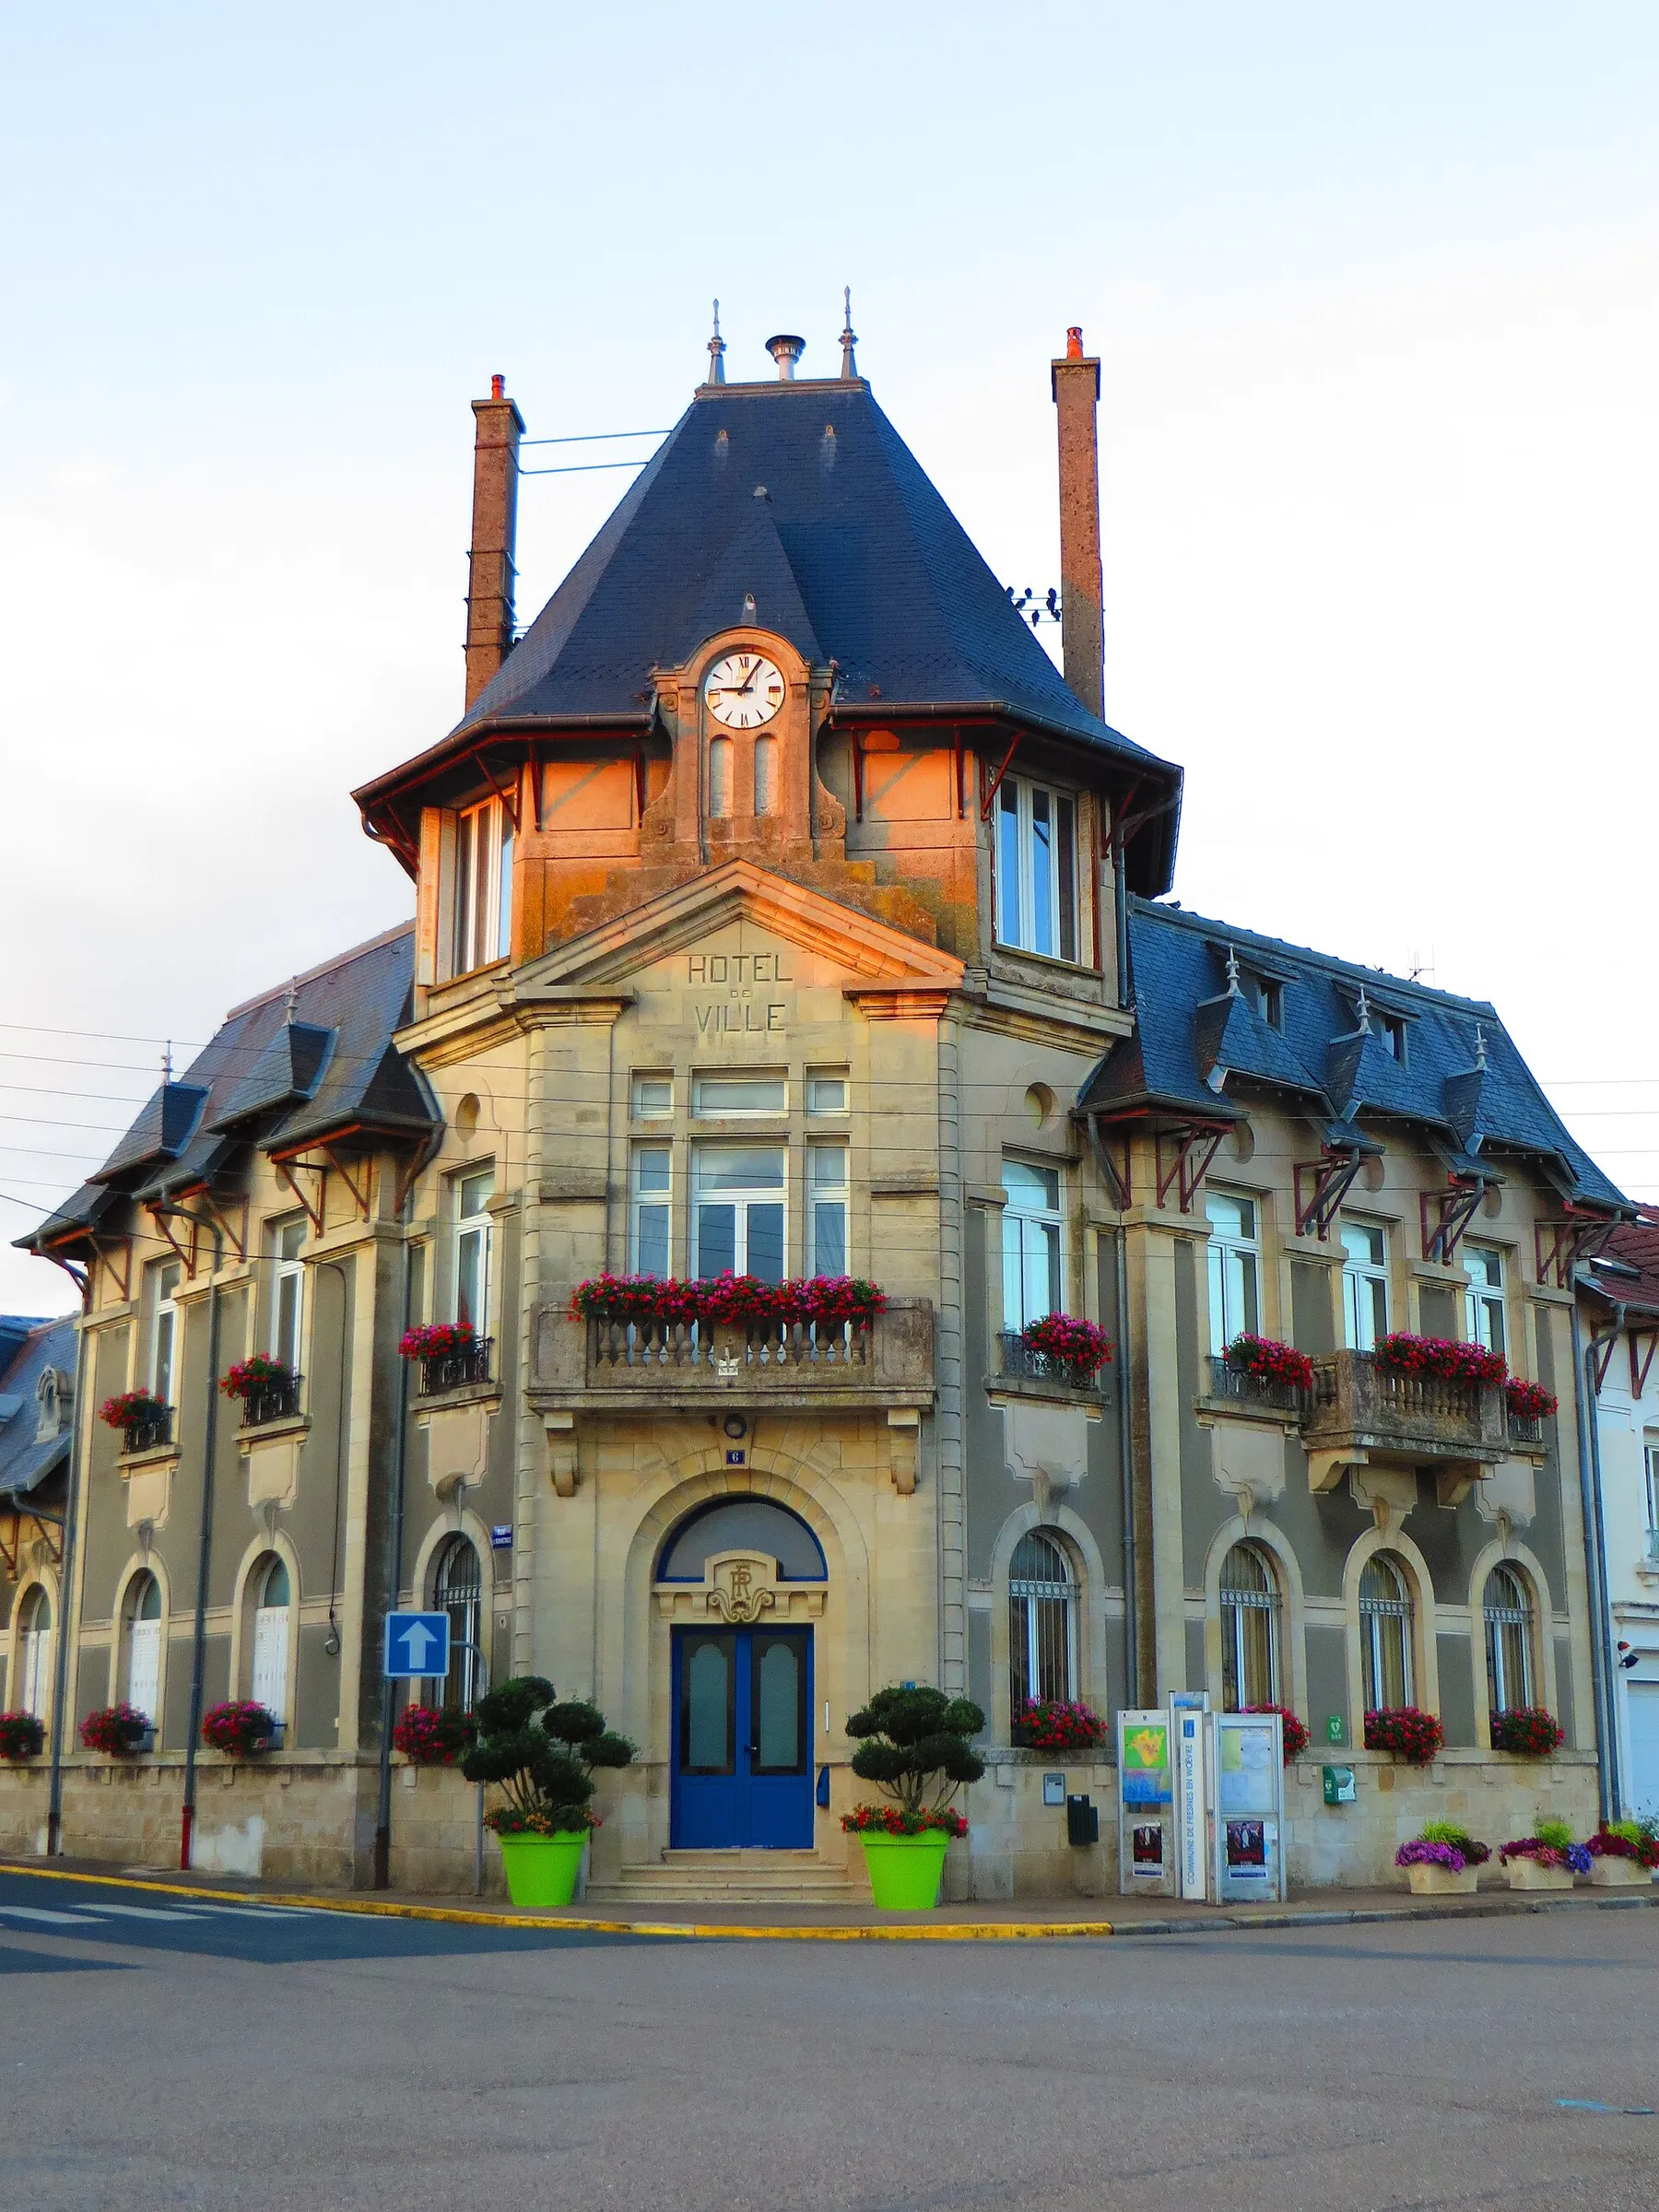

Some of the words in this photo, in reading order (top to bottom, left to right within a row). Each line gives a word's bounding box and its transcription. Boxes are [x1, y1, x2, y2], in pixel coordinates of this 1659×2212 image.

[738, 656, 749, 668] XII
[688, 955, 794, 983] HOTEL
[730, 989, 751, 998] DE
[695, 1004, 786, 1032] VILLE
[732, 1453, 739, 1462] 6
[1186, 1779, 1194, 1789] EN
[1186, 1792, 1194, 1824] FRESNES
[1187, 1827, 1194, 1837] DE
[1187, 1840, 1195, 1885] COMMUNE
